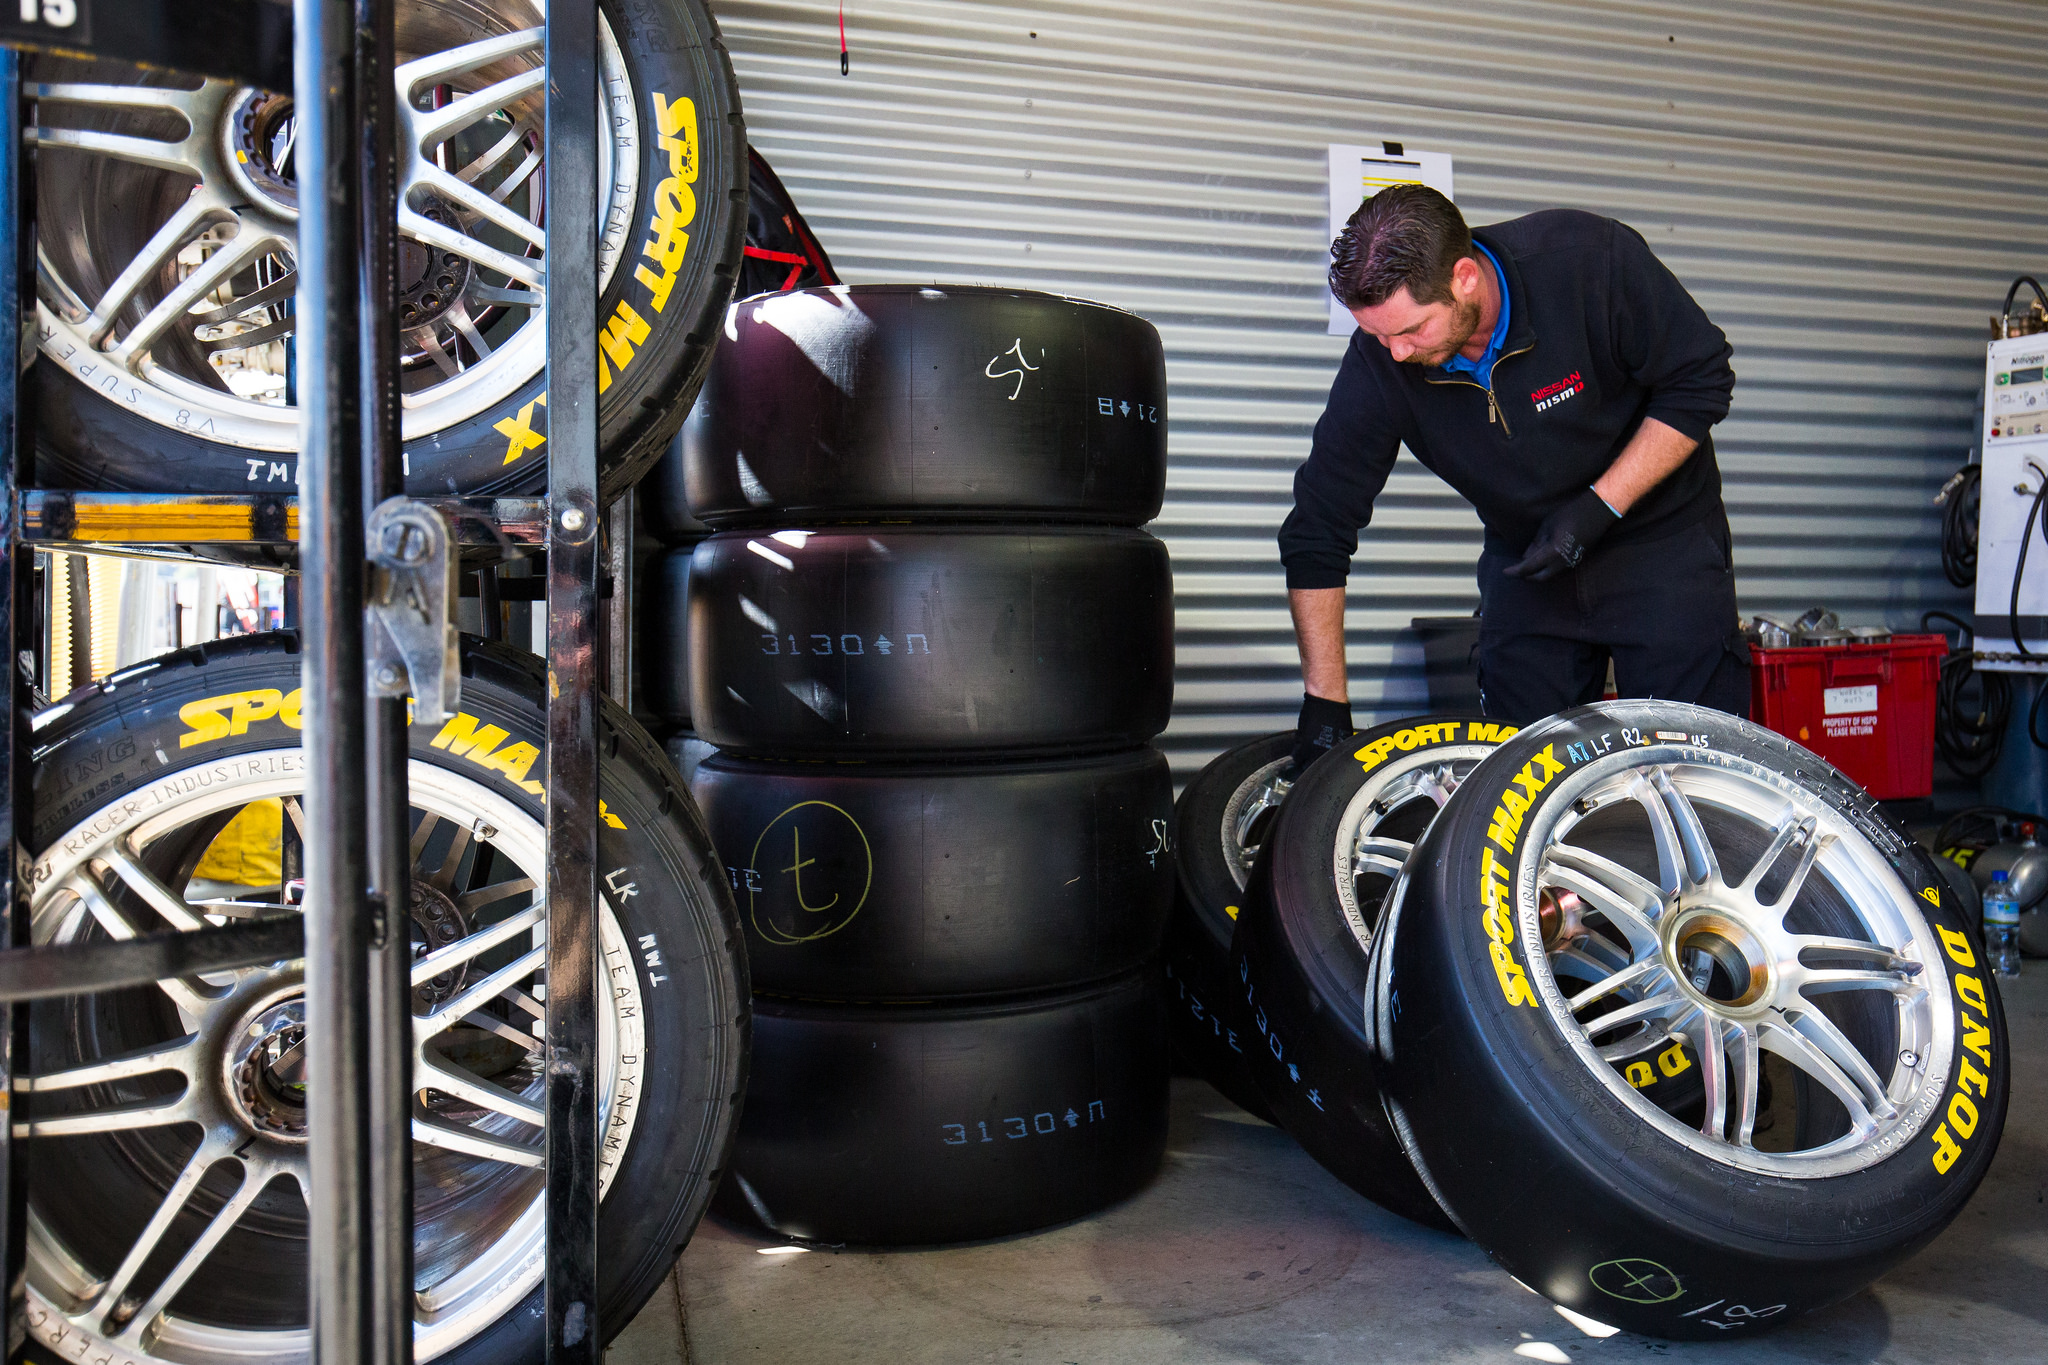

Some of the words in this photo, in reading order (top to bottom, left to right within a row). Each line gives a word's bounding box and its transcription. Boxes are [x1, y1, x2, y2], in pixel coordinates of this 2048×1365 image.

[633, 92, 699, 314] SPORT
[1530, 370, 1581, 403] NISSAN
[1535, 381, 1584, 412] nismo
[1353, 721, 1461, 773] SPORT
[1590, 733, 1612, 756] LF
[1822, 717, 1852, 728] PROPERTY
[1852, 716, 1861, 726] OF
[1826, 726, 1849, 737] PLEASE
[1849, 724, 1874, 735] RETURN
[1486, 742, 1566, 856] MAXX
[63, 801, 143, 856] RACER
[1336, 855, 1363, 928] INDUSTRIES
[1480, 846, 1539, 1008] SPORT
[605, 945, 636, 1019] TEAM
[1931, 923, 1992, 1176] DUNLOP
